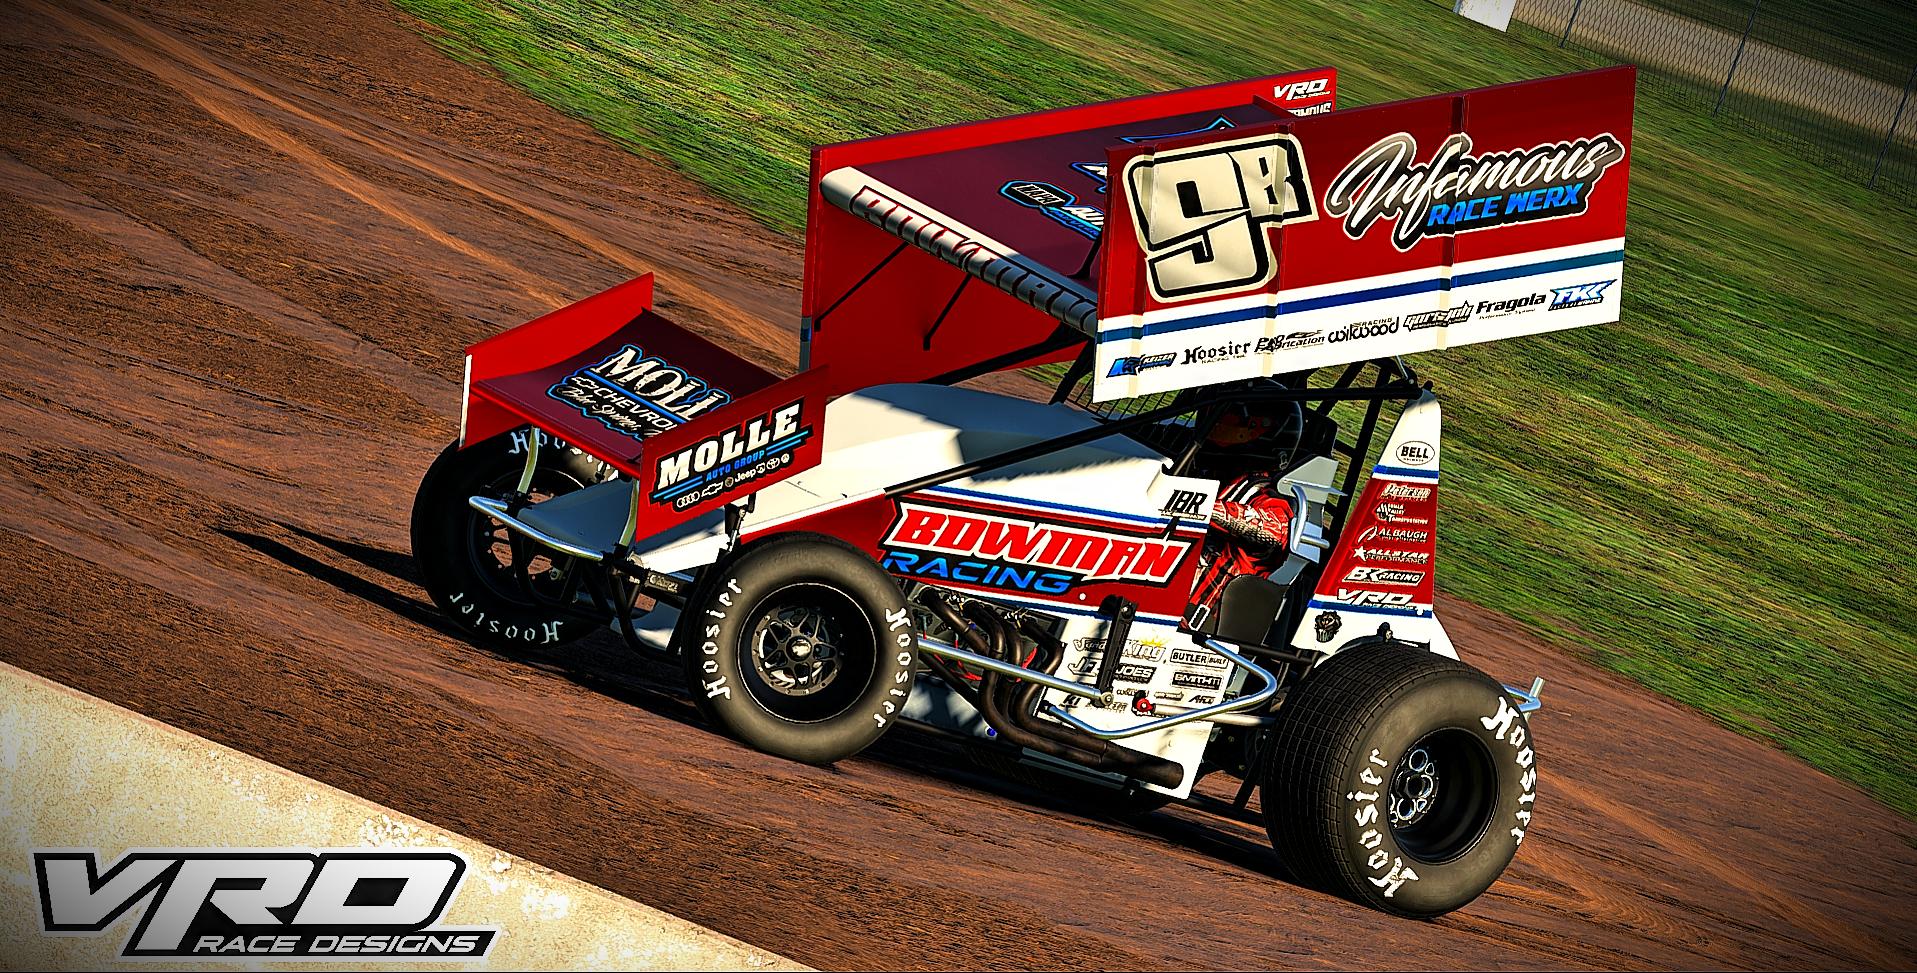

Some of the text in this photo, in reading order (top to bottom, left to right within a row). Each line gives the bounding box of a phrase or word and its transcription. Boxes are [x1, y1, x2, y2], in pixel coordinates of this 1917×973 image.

[1274, 79, 1328, 100] VRD
[1332, 139, 1616, 243] Infamous
[1428, 181, 1584, 227] RACE WERX
[1475, 293, 1547, 313] Fragola
[1328, 316, 1400, 343] wilwood
[1181, 341, 1252, 365] Hoosier
[591, 348, 724, 422] MOLL
[658, 403, 800, 491] MOLLE
[1400, 446, 1429, 459] BELL
[706, 450, 765, 482] AUTO GROUP
[735, 469, 757, 482] Jeep
[891, 508, 1184, 579] BOWMAN
[1379, 528, 1428, 540] ALBAUGH
[883, 551, 1073, 594] RACING
[1378, 572, 1421, 583] RACING
[1337, 588, 1414, 606] VRD
[450, 592, 564, 644] Hoosier
[702, 578, 742, 700] Hoosier
[873, 607, 912, 728] Hoosier
[1115, 665, 1153, 678] JOES
[1172, 651, 1208, 664] BUTLER
[1480, 696, 1537, 846] Hoosier
[1346, 748, 1419, 898] Hoosier
